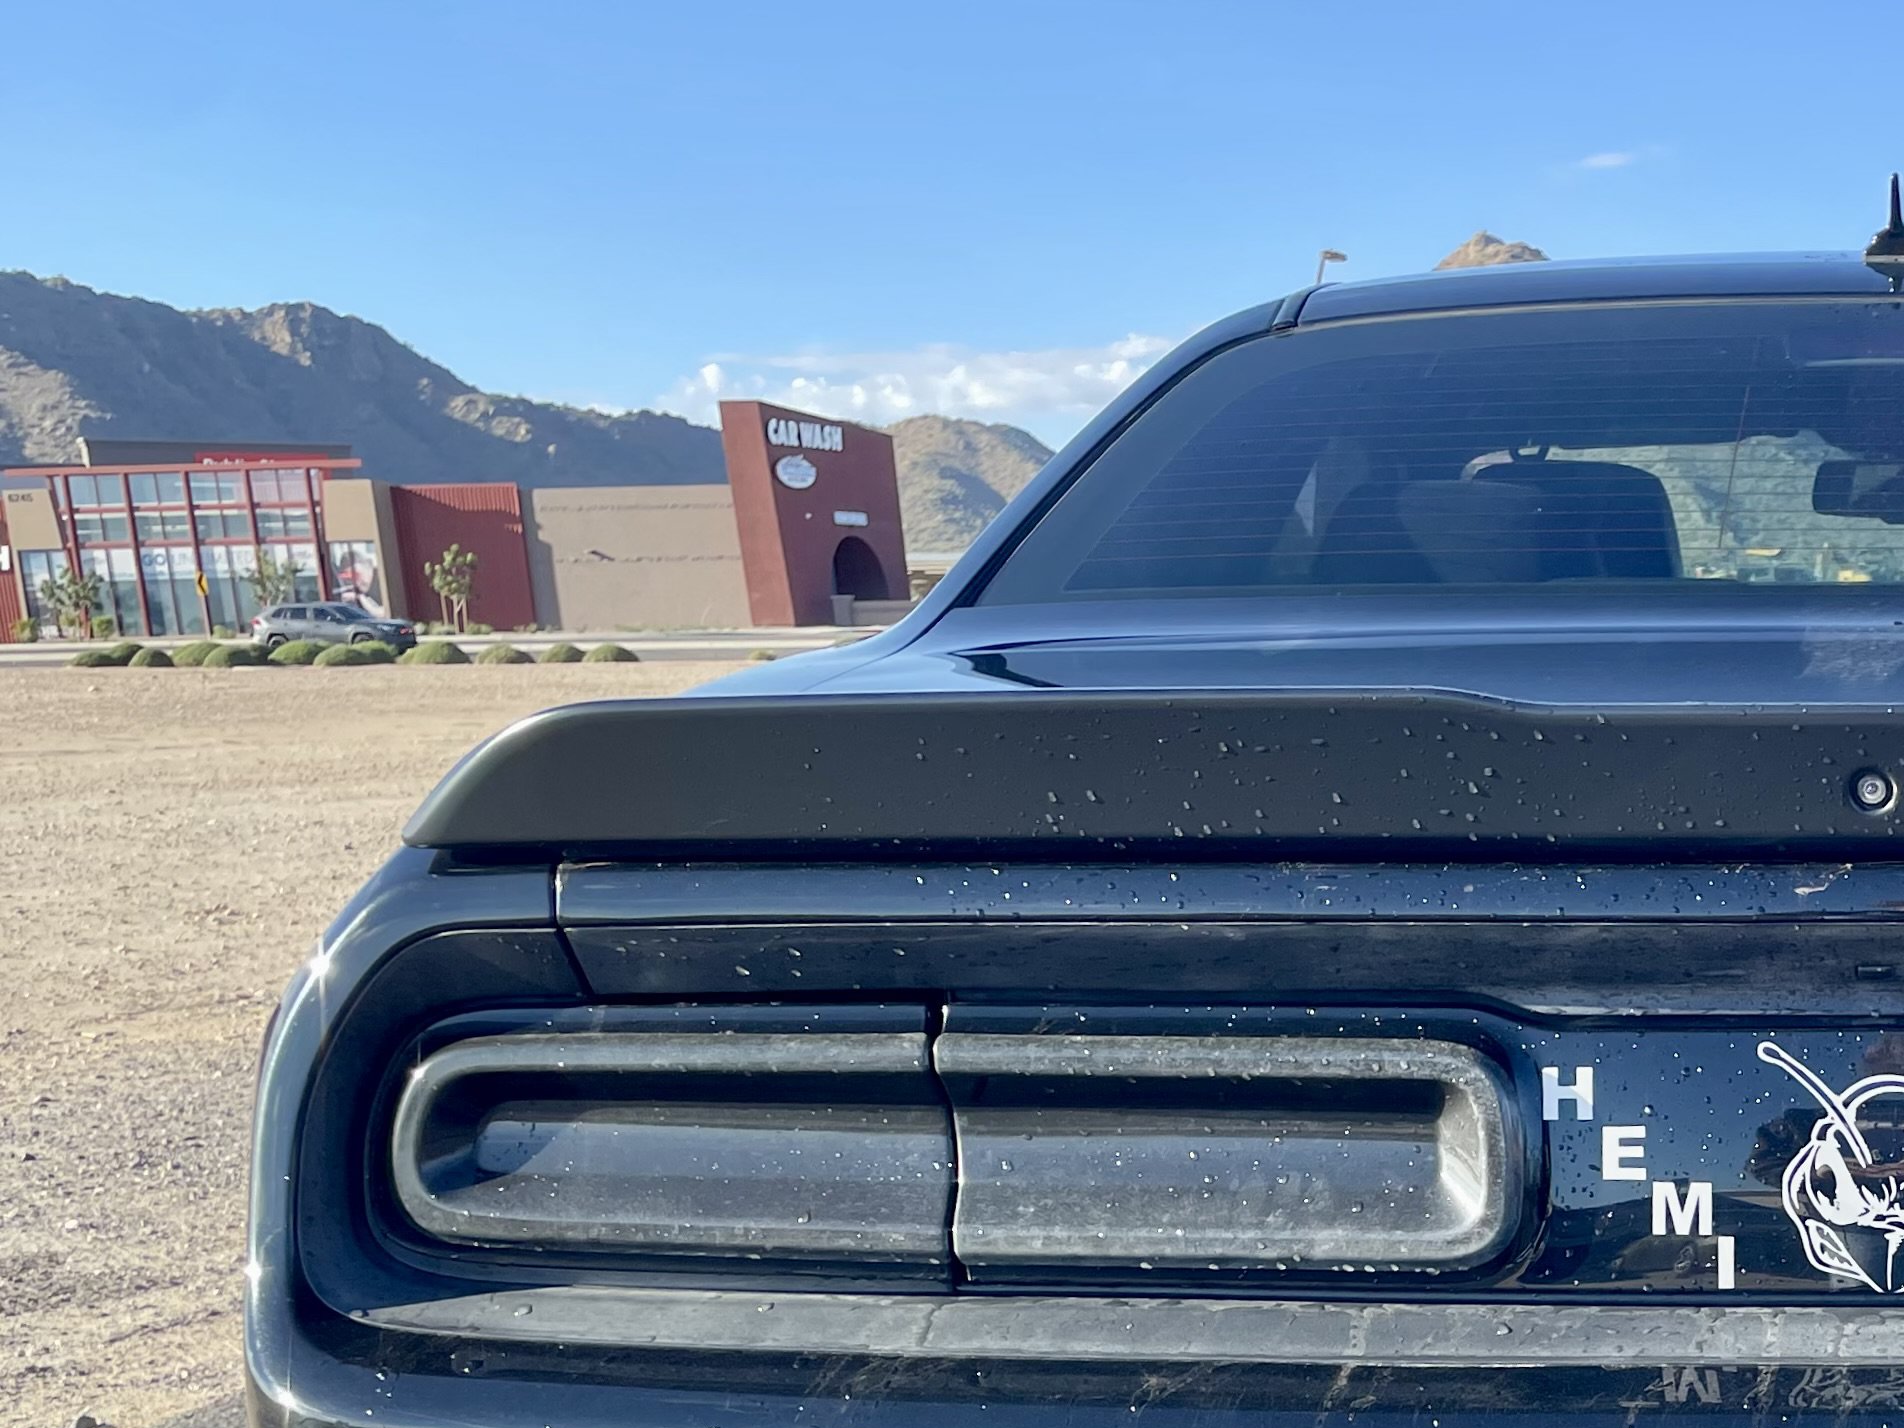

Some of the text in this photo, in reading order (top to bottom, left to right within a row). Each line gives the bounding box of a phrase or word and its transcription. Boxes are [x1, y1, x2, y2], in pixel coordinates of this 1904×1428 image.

[767, 418, 844, 452] CAR WASH
[1541, 1066, 1735, 1289] HEMI
